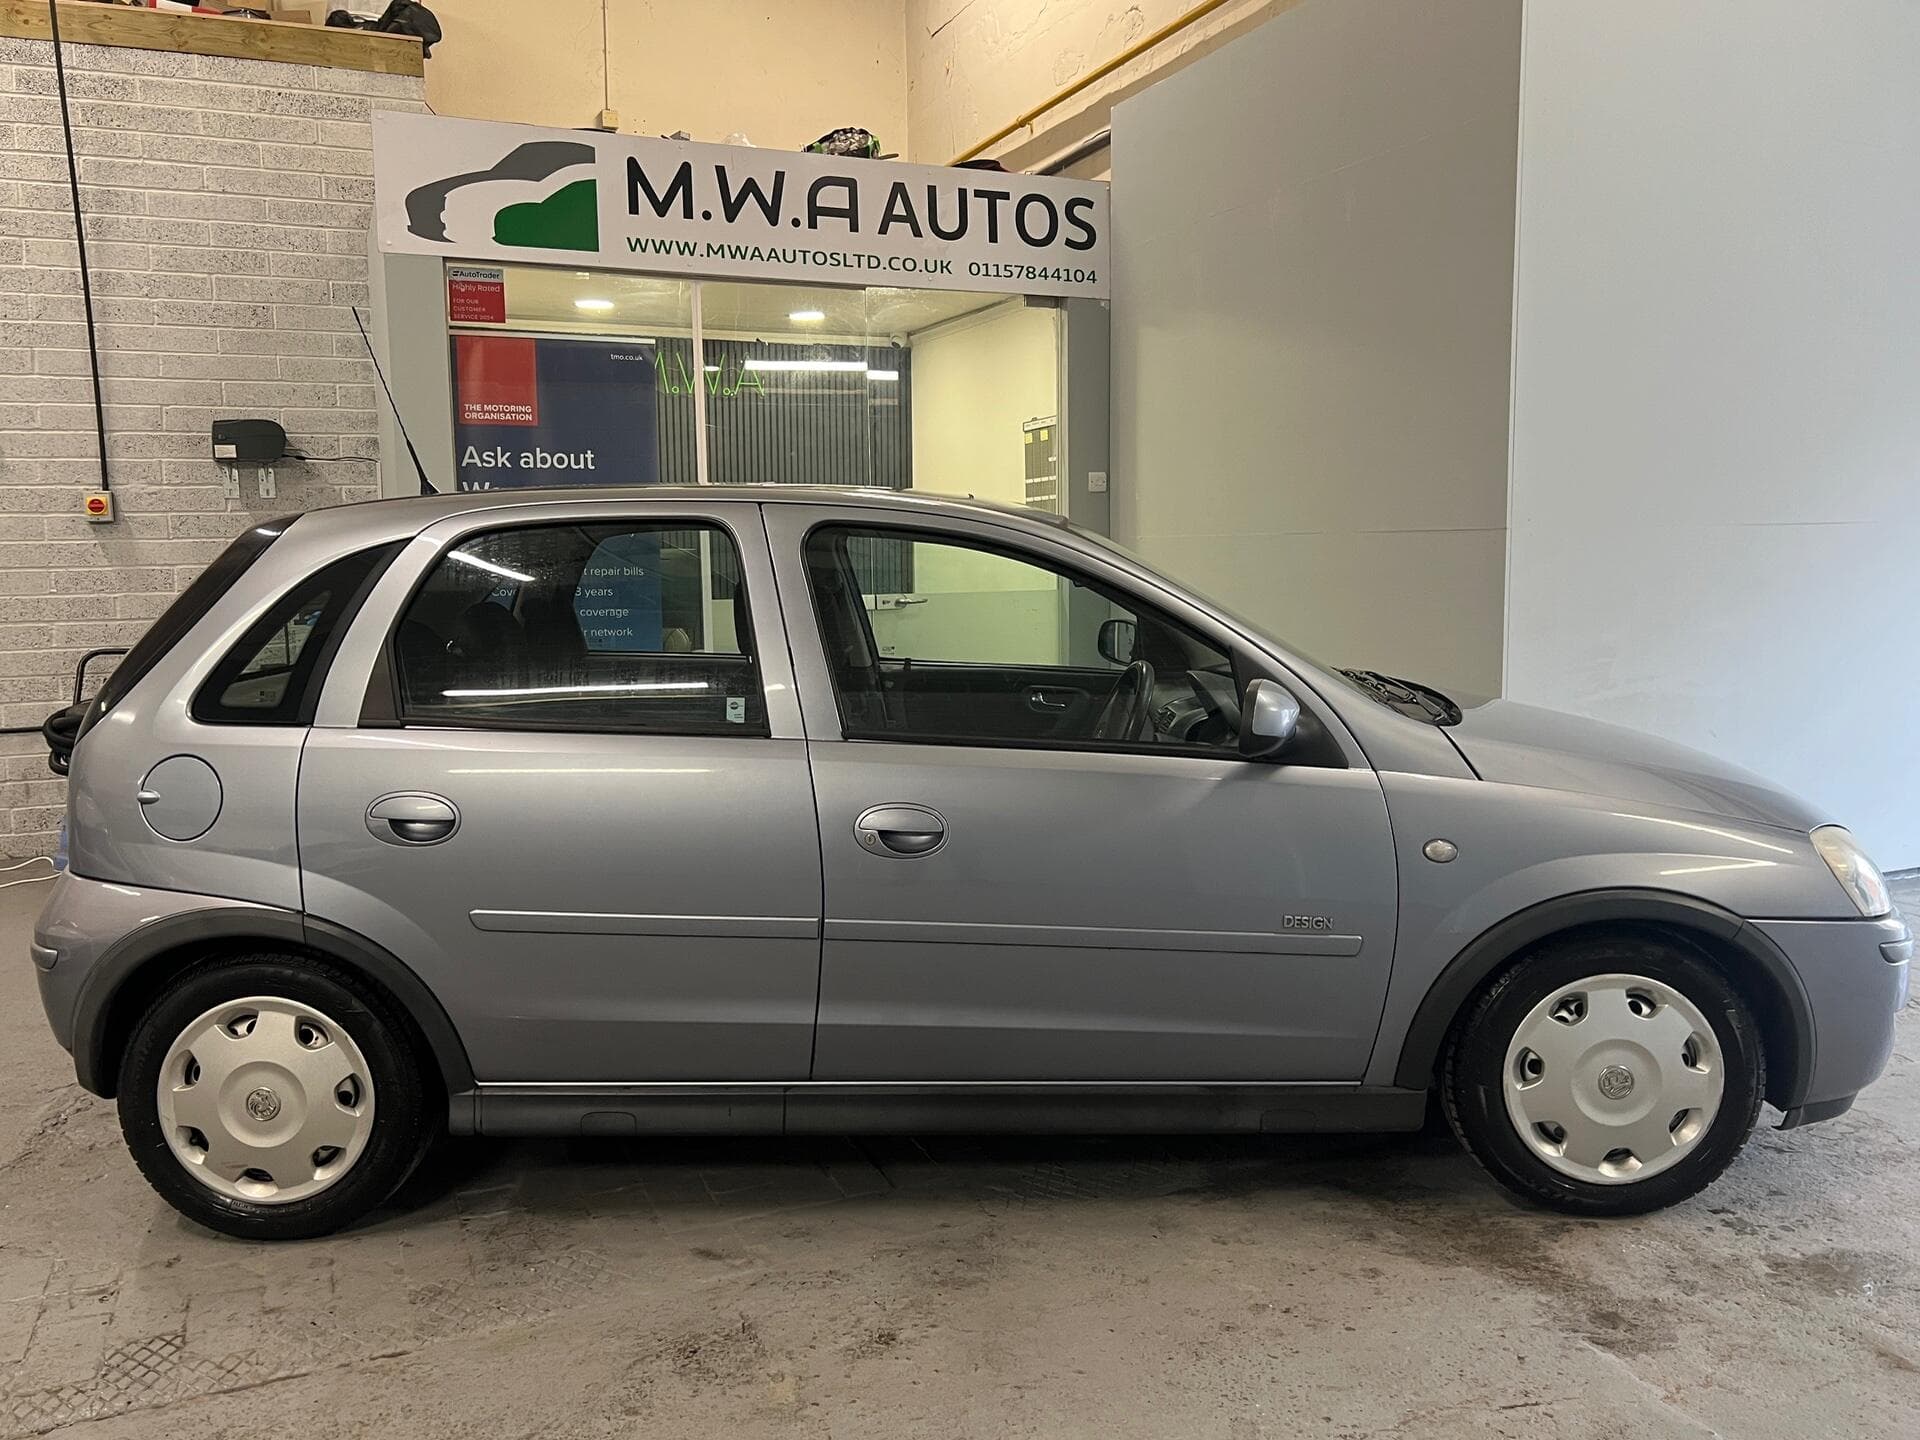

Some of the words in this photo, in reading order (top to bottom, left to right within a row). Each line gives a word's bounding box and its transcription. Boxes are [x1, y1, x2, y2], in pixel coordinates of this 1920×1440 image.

[626, 156, 859, 233] M.W.A
[877, 181, 1098, 251] AUTOS
[626, 236, 953, 275] WWW.MWAAUTOSLTD.CO.UK
[968, 261, 1098, 284] 01157844104
[610, 353, 643, 361] tmo.co.uk
[483, 404, 532, 413] MOTORING
[464, 412, 533, 421] ORGANISATION
[461, 446, 512, 468] Ask
[519, 447, 596, 470] about
[590, 567, 620, 577] repair
[624, 566, 645, 576] bills
[585, 588, 614, 598] years
[579, 608, 630, 618] coverage
[591, 627, 634, 637] network
[1283, 915, 1333, 929] DESIGN
